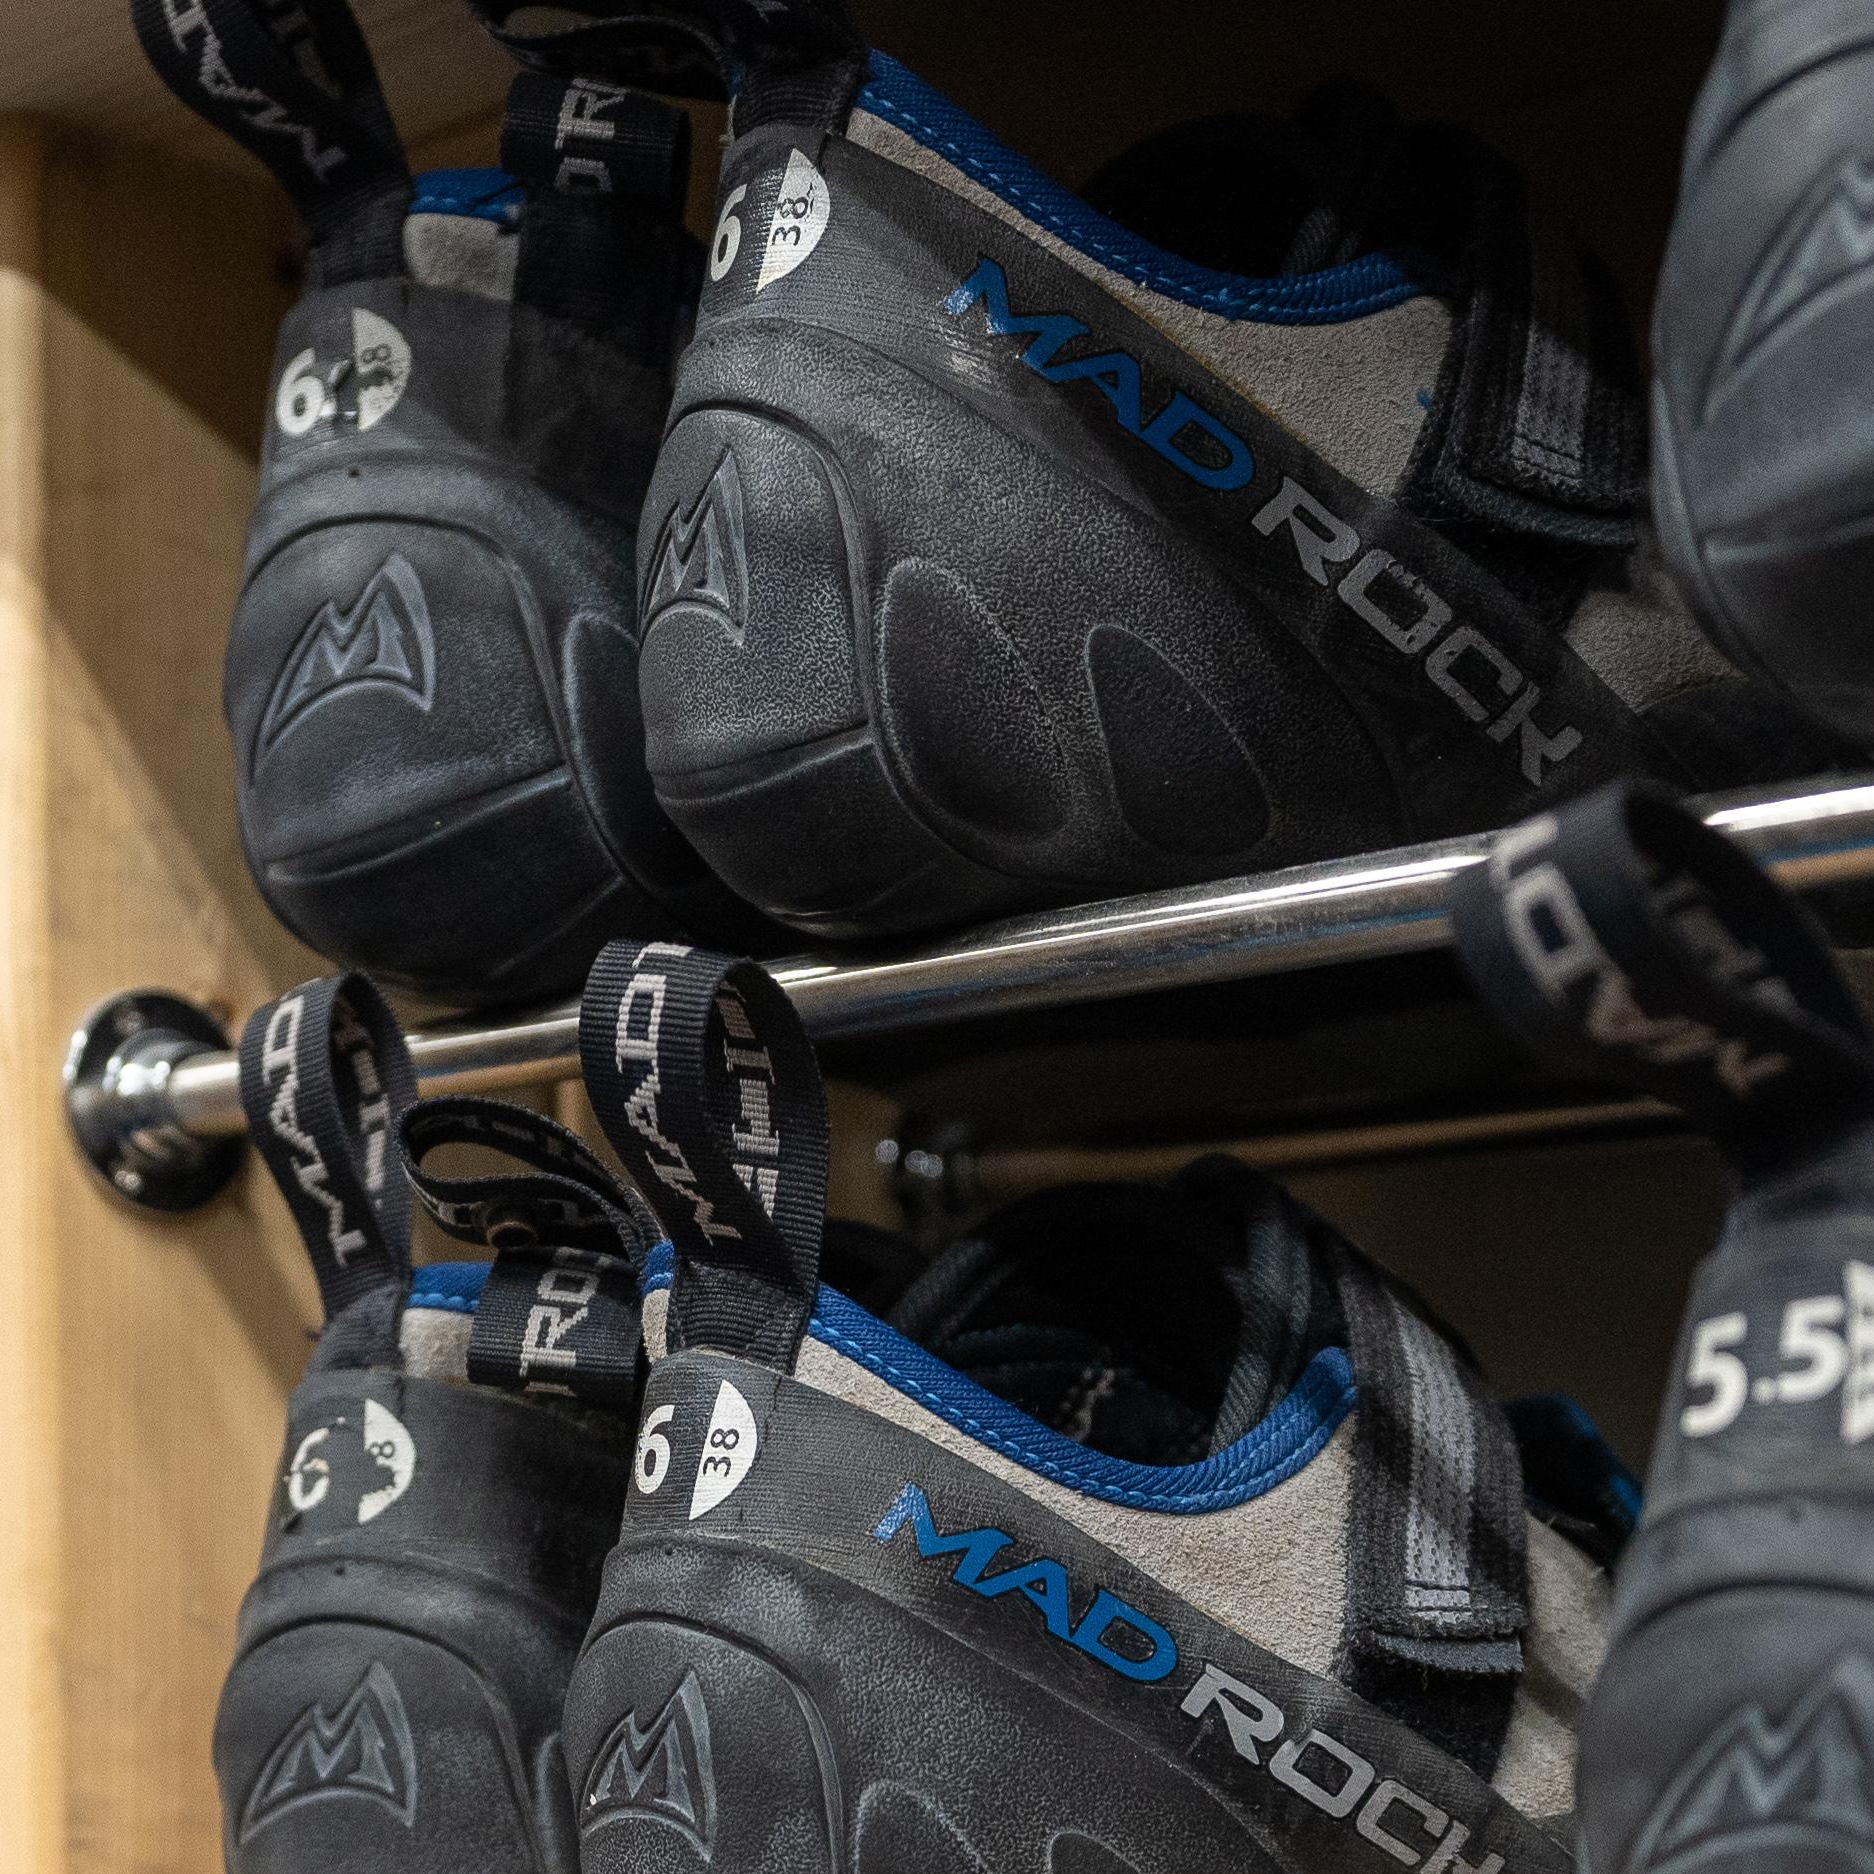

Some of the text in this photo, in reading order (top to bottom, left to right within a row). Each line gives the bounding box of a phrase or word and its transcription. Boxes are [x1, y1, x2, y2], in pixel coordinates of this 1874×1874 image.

[711, 184, 748, 281] 6
[942, 257, 1584, 787] MAD ROCK
[261, 994, 368, 1267] MAD
[613, 974, 743, 1248] MAD
[635, 1404, 676, 1495] 6
[702, 1426, 741, 1478] 38
[1681, 1294, 1850, 1438] 5.5
[872, 1482, 1179, 1682] MAD
